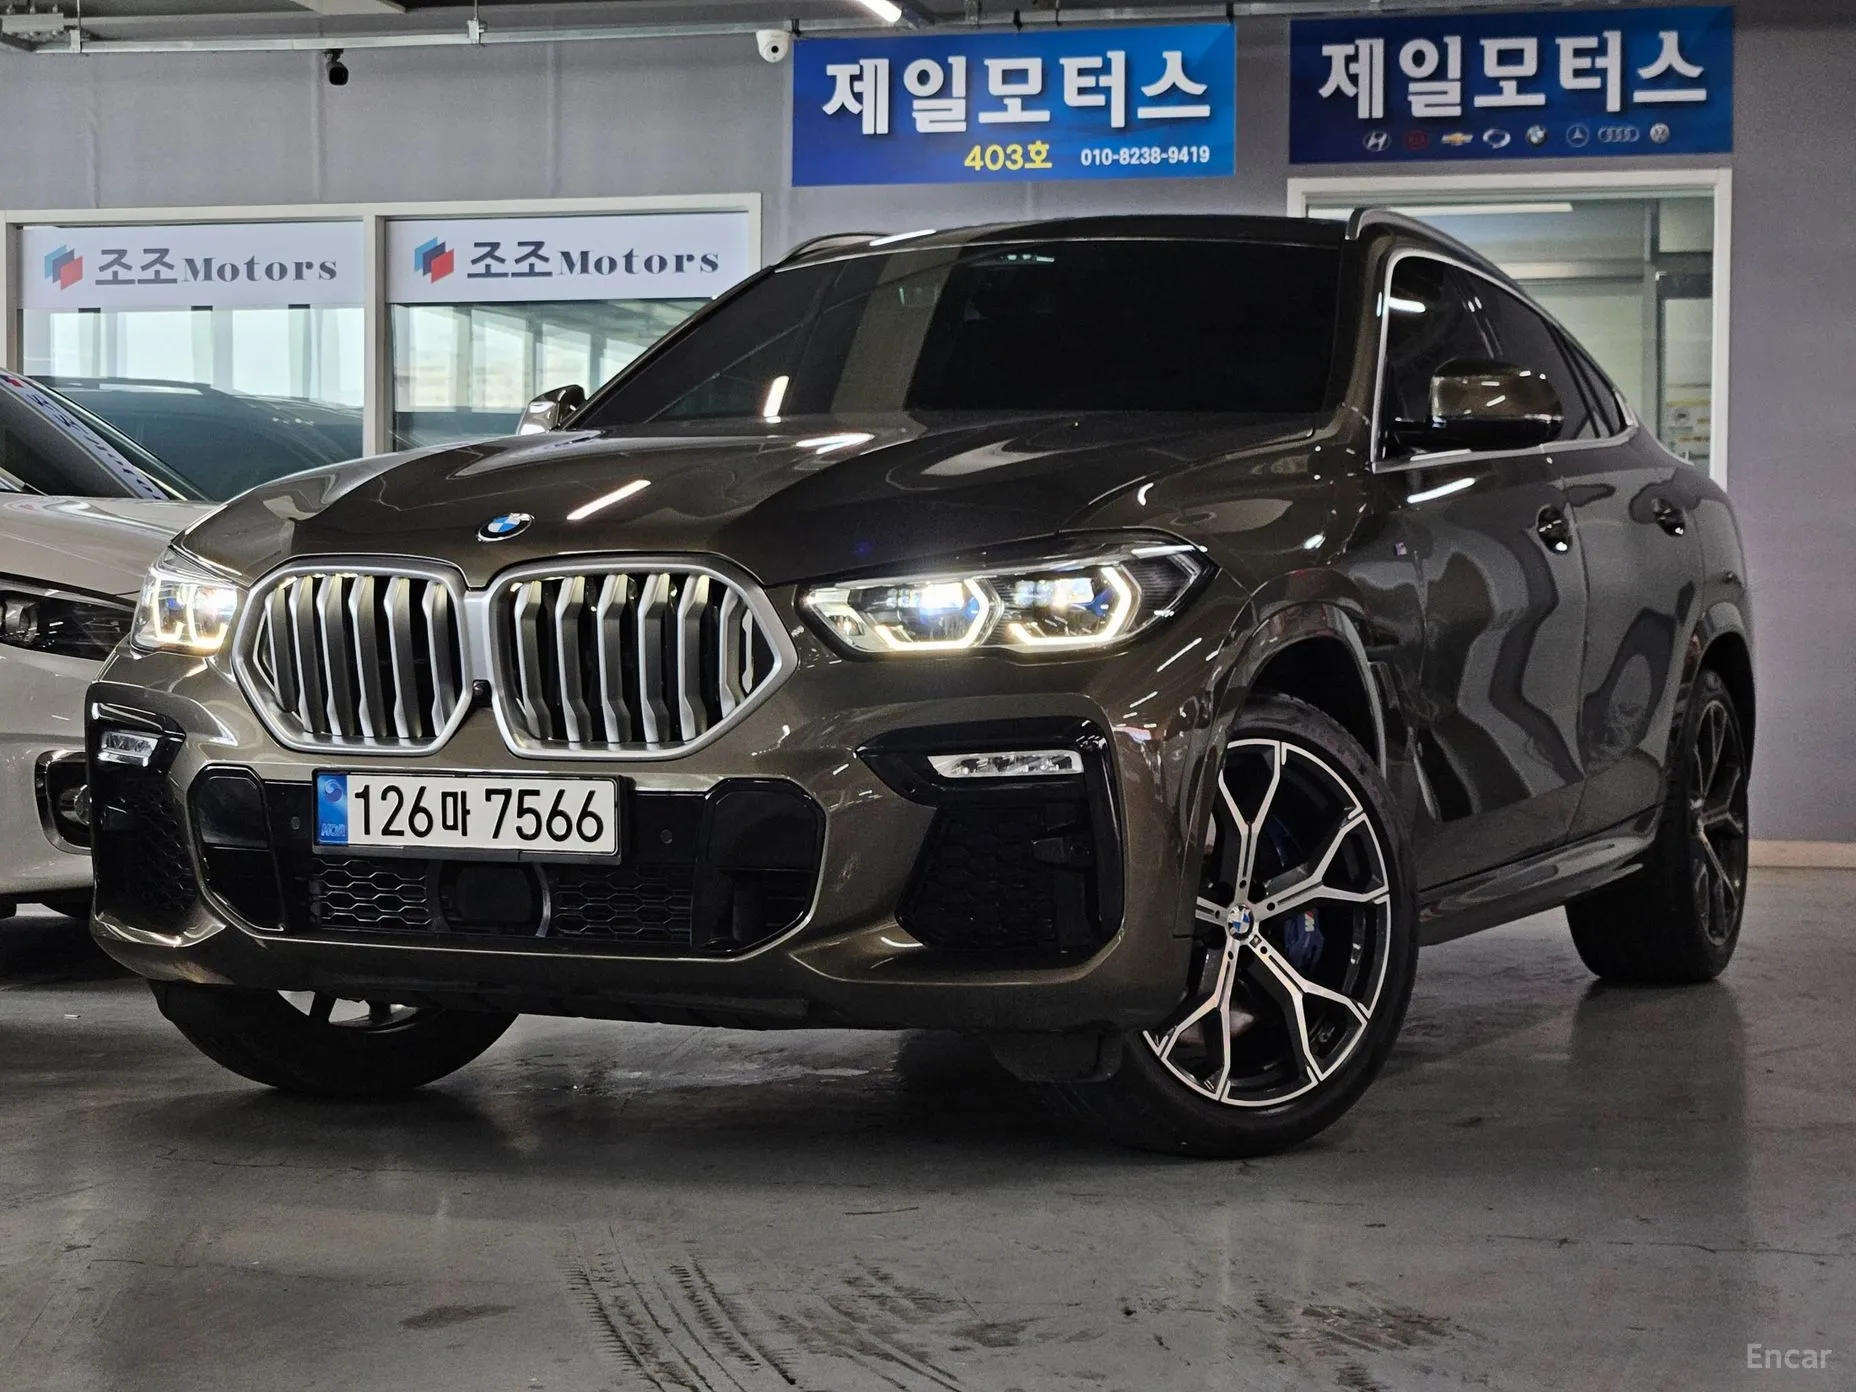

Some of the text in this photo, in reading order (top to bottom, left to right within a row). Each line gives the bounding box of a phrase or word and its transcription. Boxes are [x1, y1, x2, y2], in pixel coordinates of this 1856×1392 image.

[821, 49, 1211, 135] 제일모터스
[1318, 30, 1707, 120] 제일모터스
[964, 140, 1210, 171] 403호 010-8238-9419
[354, 784, 604, 842] 126마 7566
